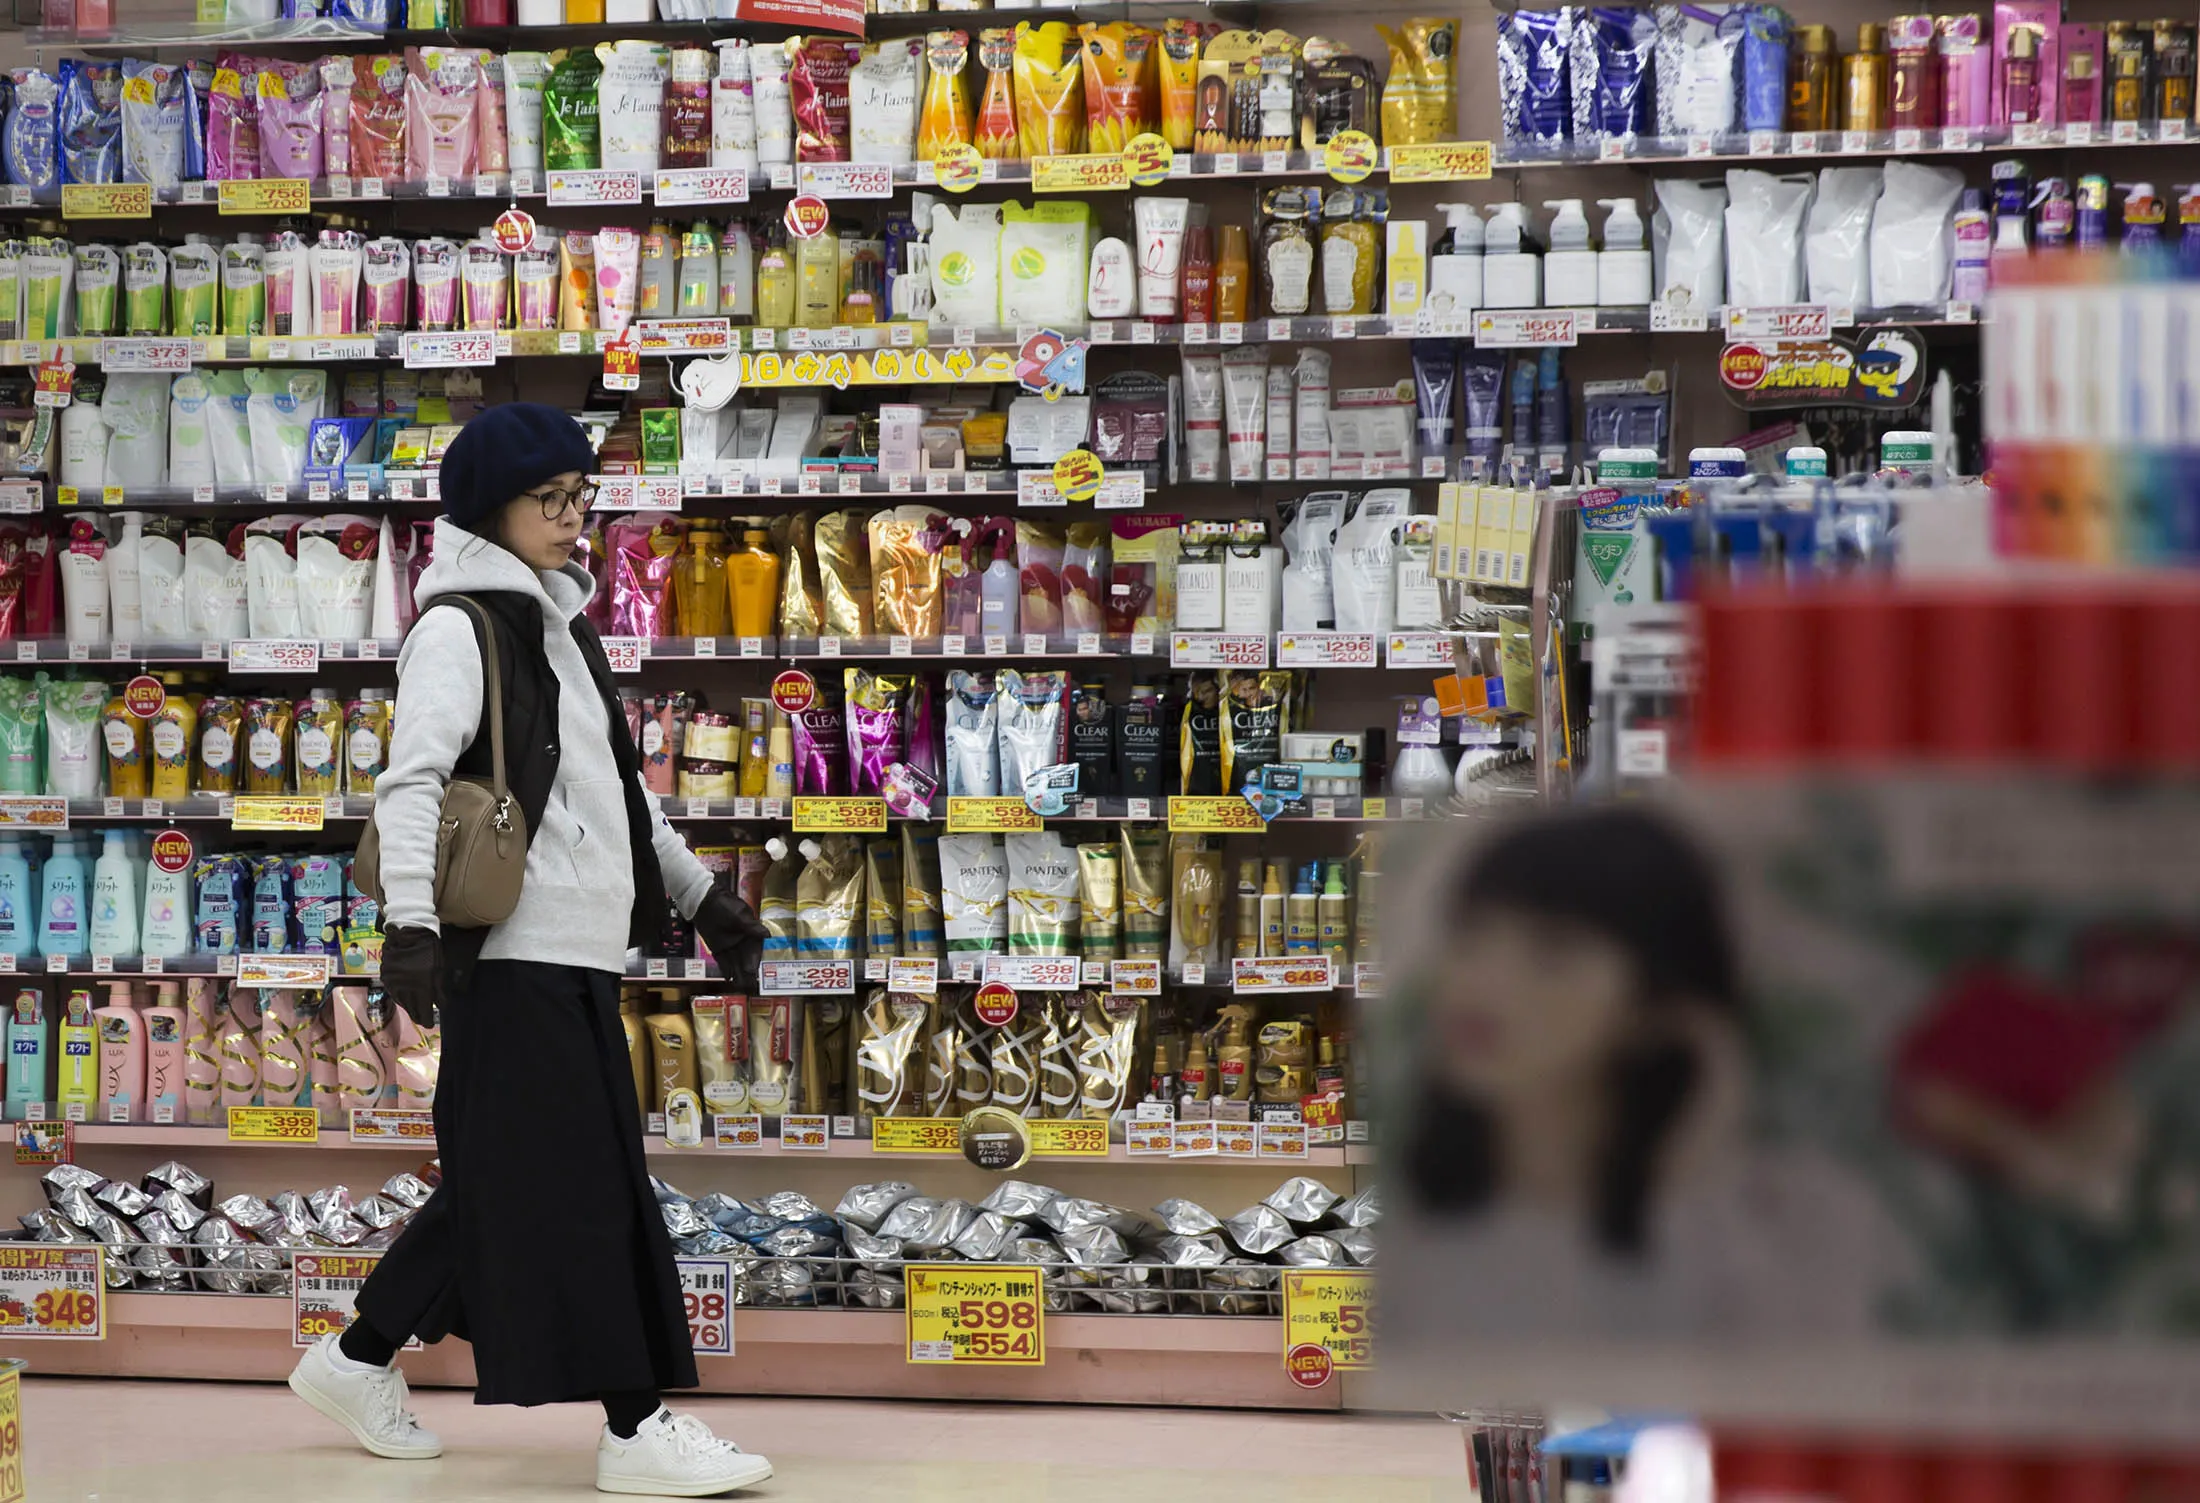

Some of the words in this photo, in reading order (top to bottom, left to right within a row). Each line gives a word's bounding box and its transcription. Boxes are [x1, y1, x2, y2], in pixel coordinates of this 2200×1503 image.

[612, 94, 629, 115] Je
[1080, 164, 1123, 175] 648
[701, 177, 743, 188] 972
[844, 172, 887, 183] 756
[1086, 175, 1122, 185] 600
[594, 179, 636, 189] 756
[851, 183, 886, 193] 700
[107, 193, 146, 203] 756
[264, 188, 304, 199] 756
[601, 190, 635, 200] 700
[708, 189, 741, 198] 900
[113, 204, 144, 213] 700
[270, 199, 303, 208] 700
[685, 334, 725, 346] 798
[450, 341, 490, 351] 373
[147, 347, 186, 358] 373
[610, 487, 632, 496] 92
[656, 488, 678, 496] 92
[1126, 517, 1171, 527] TSUBAKI
[1218, 642, 1263, 653] 1512
[1326, 641, 1370, 652] 1296
[273, 649, 313, 659] 529
[1225, 653, 1262, 664] 1400
[1332, 653, 1369, 662] 1200
[127, 687, 162, 701] NEW
[775, 684, 813, 696] NEW
[1234, 713, 1279, 730] CLEAR
[1073, 725, 1109, 737] CLEAR
[1124, 724, 1160, 737] CLEAR
[279, 807, 319, 817] 448
[839, 806, 881, 817] 598
[1216, 805, 1259, 817] 598
[844, 817, 879, 827] 554
[1001, 817, 1036, 827] 554
[1222, 817, 1258, 827] 554
[154, 842, 191, 856] NEW
[961, 866, 1005, 876] PANTENE
[1025, 865, 1070, 876] PANTENE
[52, 882, 76, 892] メリット
[96, 882, 119, 892] メリット
[151, 882, 176, 892] メリット
[302, 879, 327, 889] メリット
[807, 968, 849, 978] 298
[1031, 965, 1073, 974] 298
[1037, 974, 1071, 984] 276
[1284, 970, 1327, 983] 648
[813, 979, 848, 988] 276
[977, 995, 1015, 1008] NEW
[15, 1042, 37, 1053] オクト
[67, 1043, 90, 1054] オクト
[108, 1055, 128, 1098] LUX
[155, 1061, 172, 1098] LUX
[273, 1117, 313, 1127] 399
[279, 1127, 311, 1137] 370
[398, 1123, 436, 1136] 598
[1060, 1129, 1103, 1141] 399
[1065, 1140, 1101, 1151] 370
[1, 1270, 62, 1281] なめらかスムースケア
[939, 1282, 1002, 1297] パンテーンシャンプー
[35, 1292, 96, 1325] 348
[300, 1303, 329, 1311] 378
[942, 1306, 960, 1319] 税込
[959, 1300, 1035, 1329] 598
[1320, 1311, 1338, 1323] 税込
[300, 1318, 329, 1335] 30
[1289, 1355, 1328, 1371] NEW
